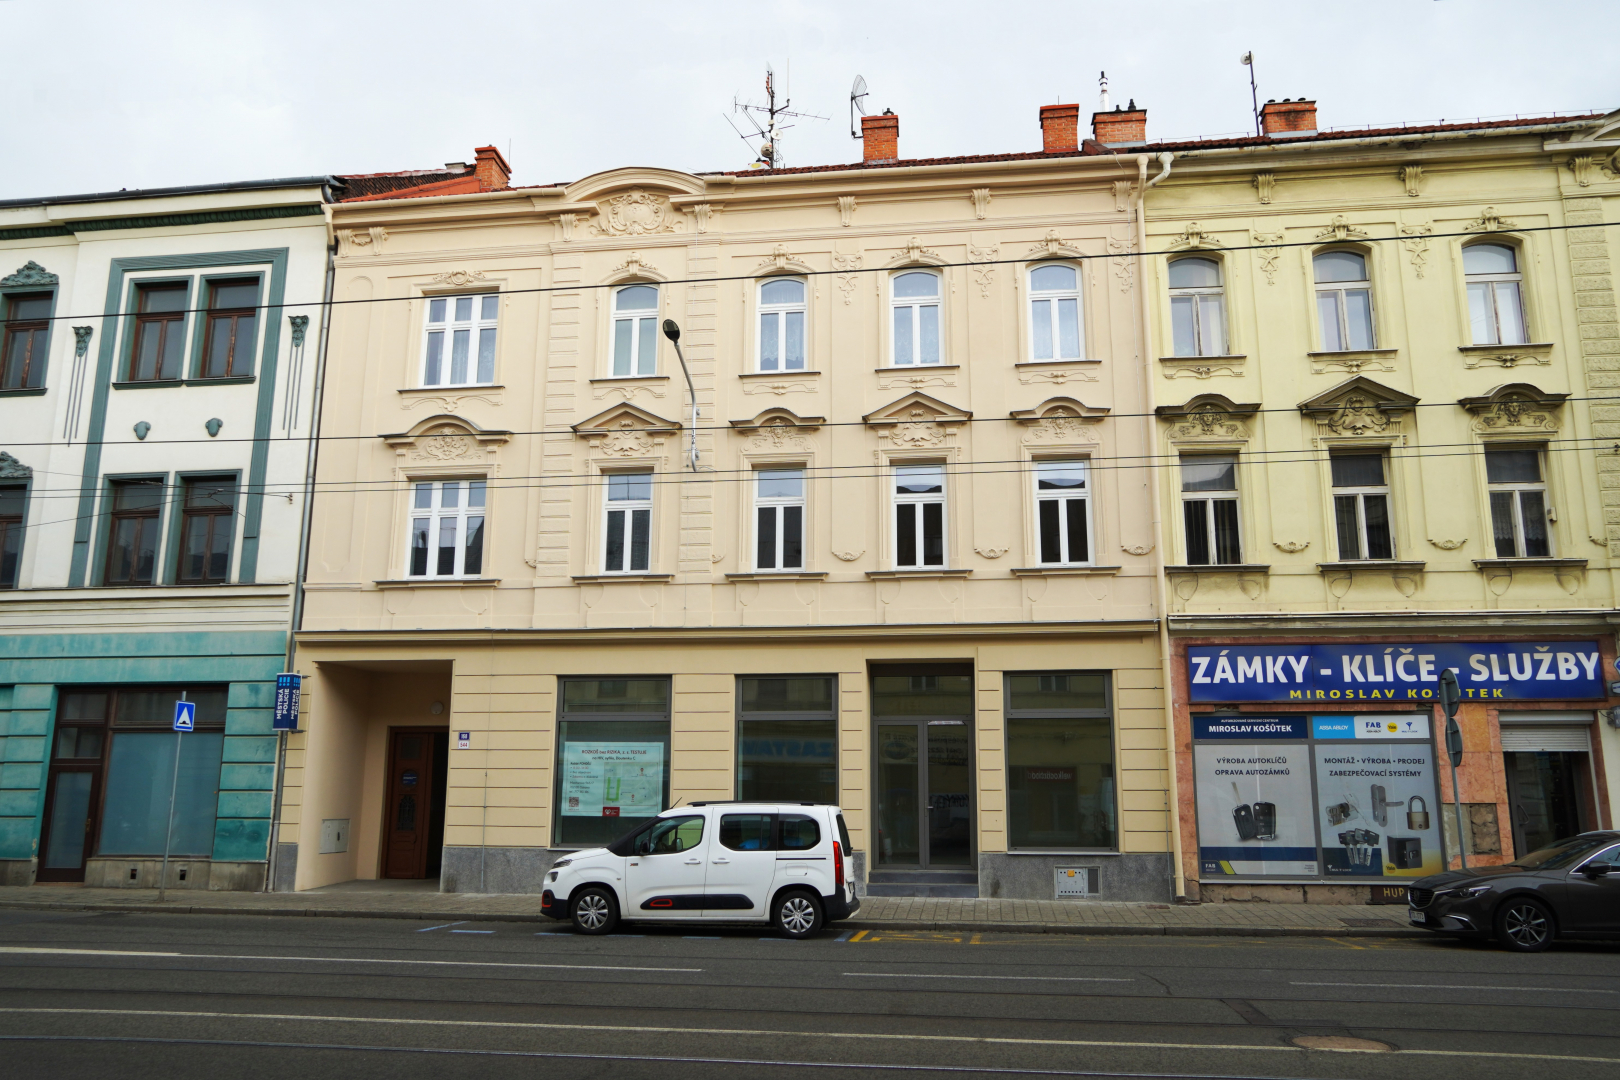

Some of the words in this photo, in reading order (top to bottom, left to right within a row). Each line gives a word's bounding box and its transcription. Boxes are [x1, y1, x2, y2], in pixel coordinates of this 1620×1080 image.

[1191, 650, 1309, 683] ZÁMKY
[1342, 648, 1438, 682] KLÍČE
[1469, 646, 1600, 682] SLUŽBY
[1290, 689, 1395, 699] MIROSLAV
[1408, 689, 1504, 698] KOTEK
[276, 688, 284, 720] MĚSTSKÁ
[1208, 725, 1251, 733] MIROSLAV
[1253, 723, 1292, 732] KOŠŮTEK
[1247, 756, 1287, 764] AUTOKLÍČŮ
[1245, 767, 1290, 775] AUTOZÁMKŮ
[1329, 769, 1387, 777] ZABEZPEČOVACÍ
[1388, 769, 1421, 777] SYSTÉMY
[1383, 887, 1405, 897] HUP
